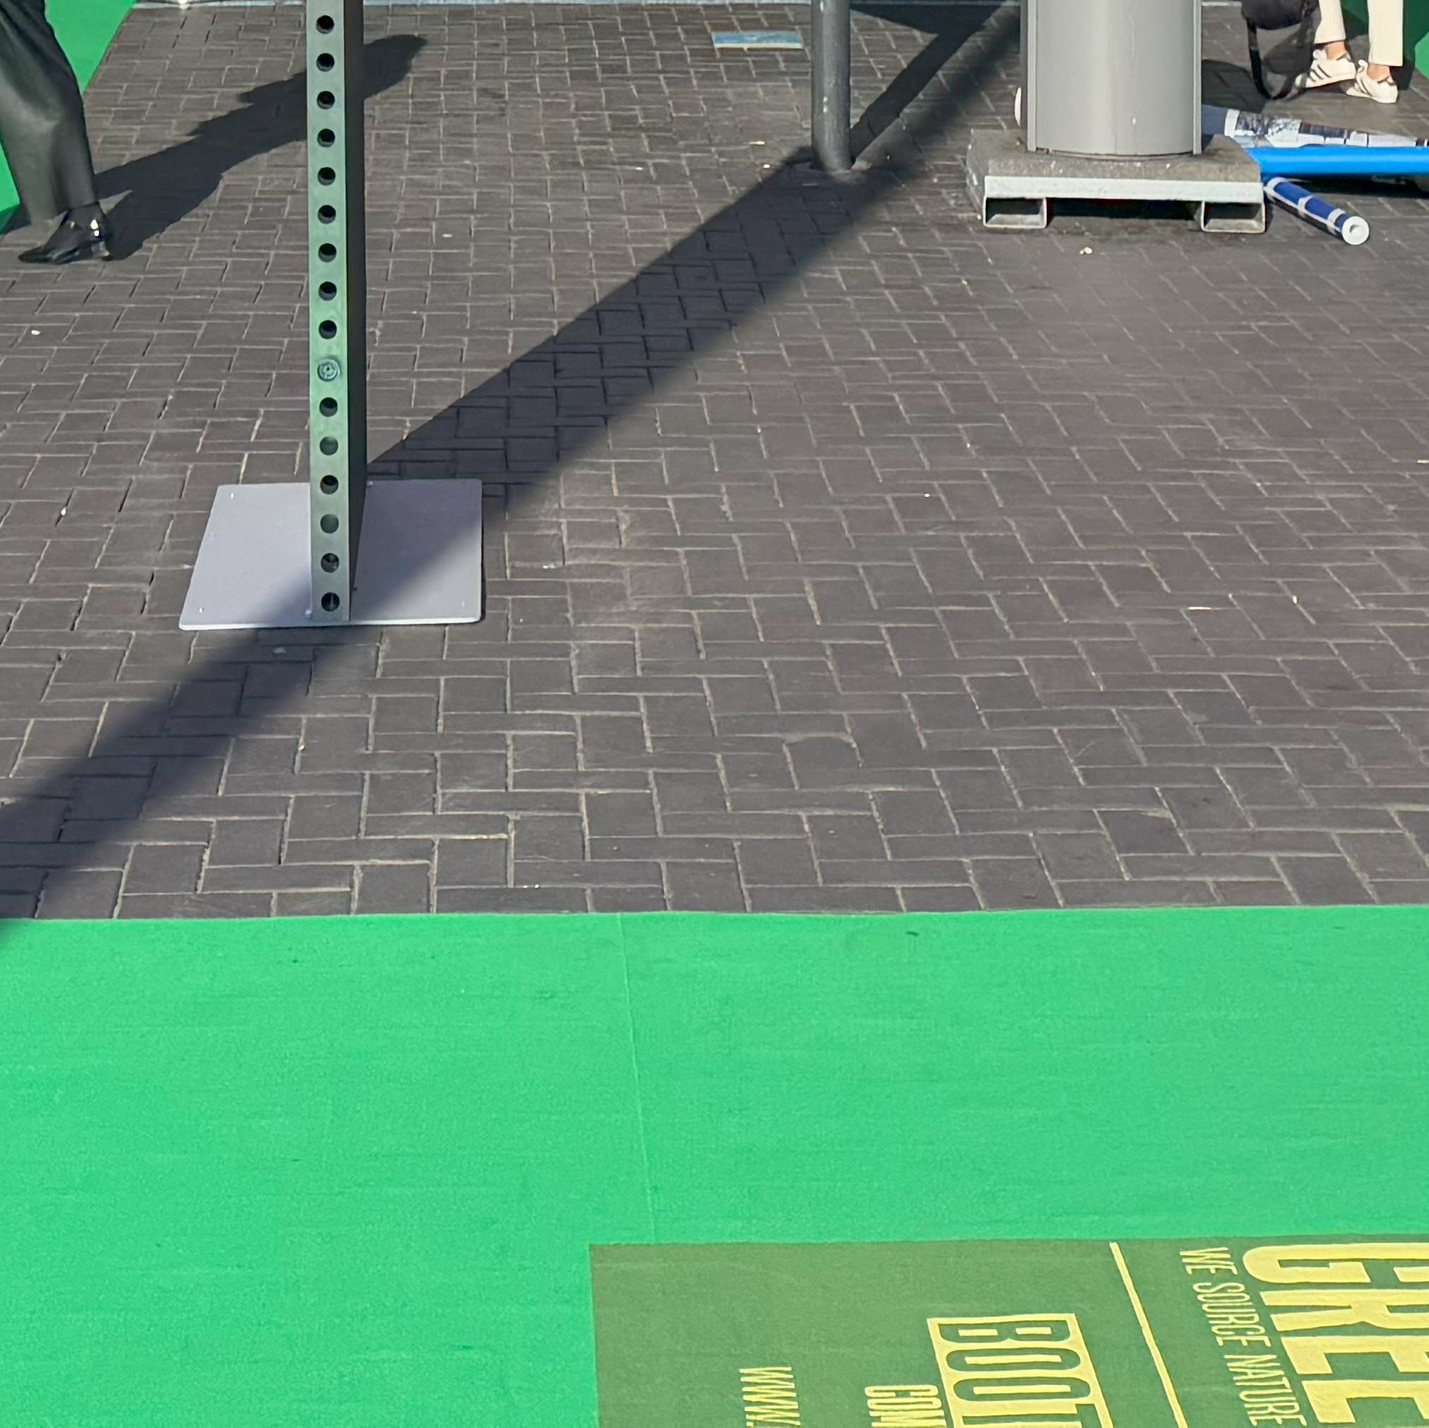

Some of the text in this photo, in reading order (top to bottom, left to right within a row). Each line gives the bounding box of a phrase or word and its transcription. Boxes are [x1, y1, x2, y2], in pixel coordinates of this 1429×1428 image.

[1179, 1246, 1308, 1427] WE SOURCE NATURE
